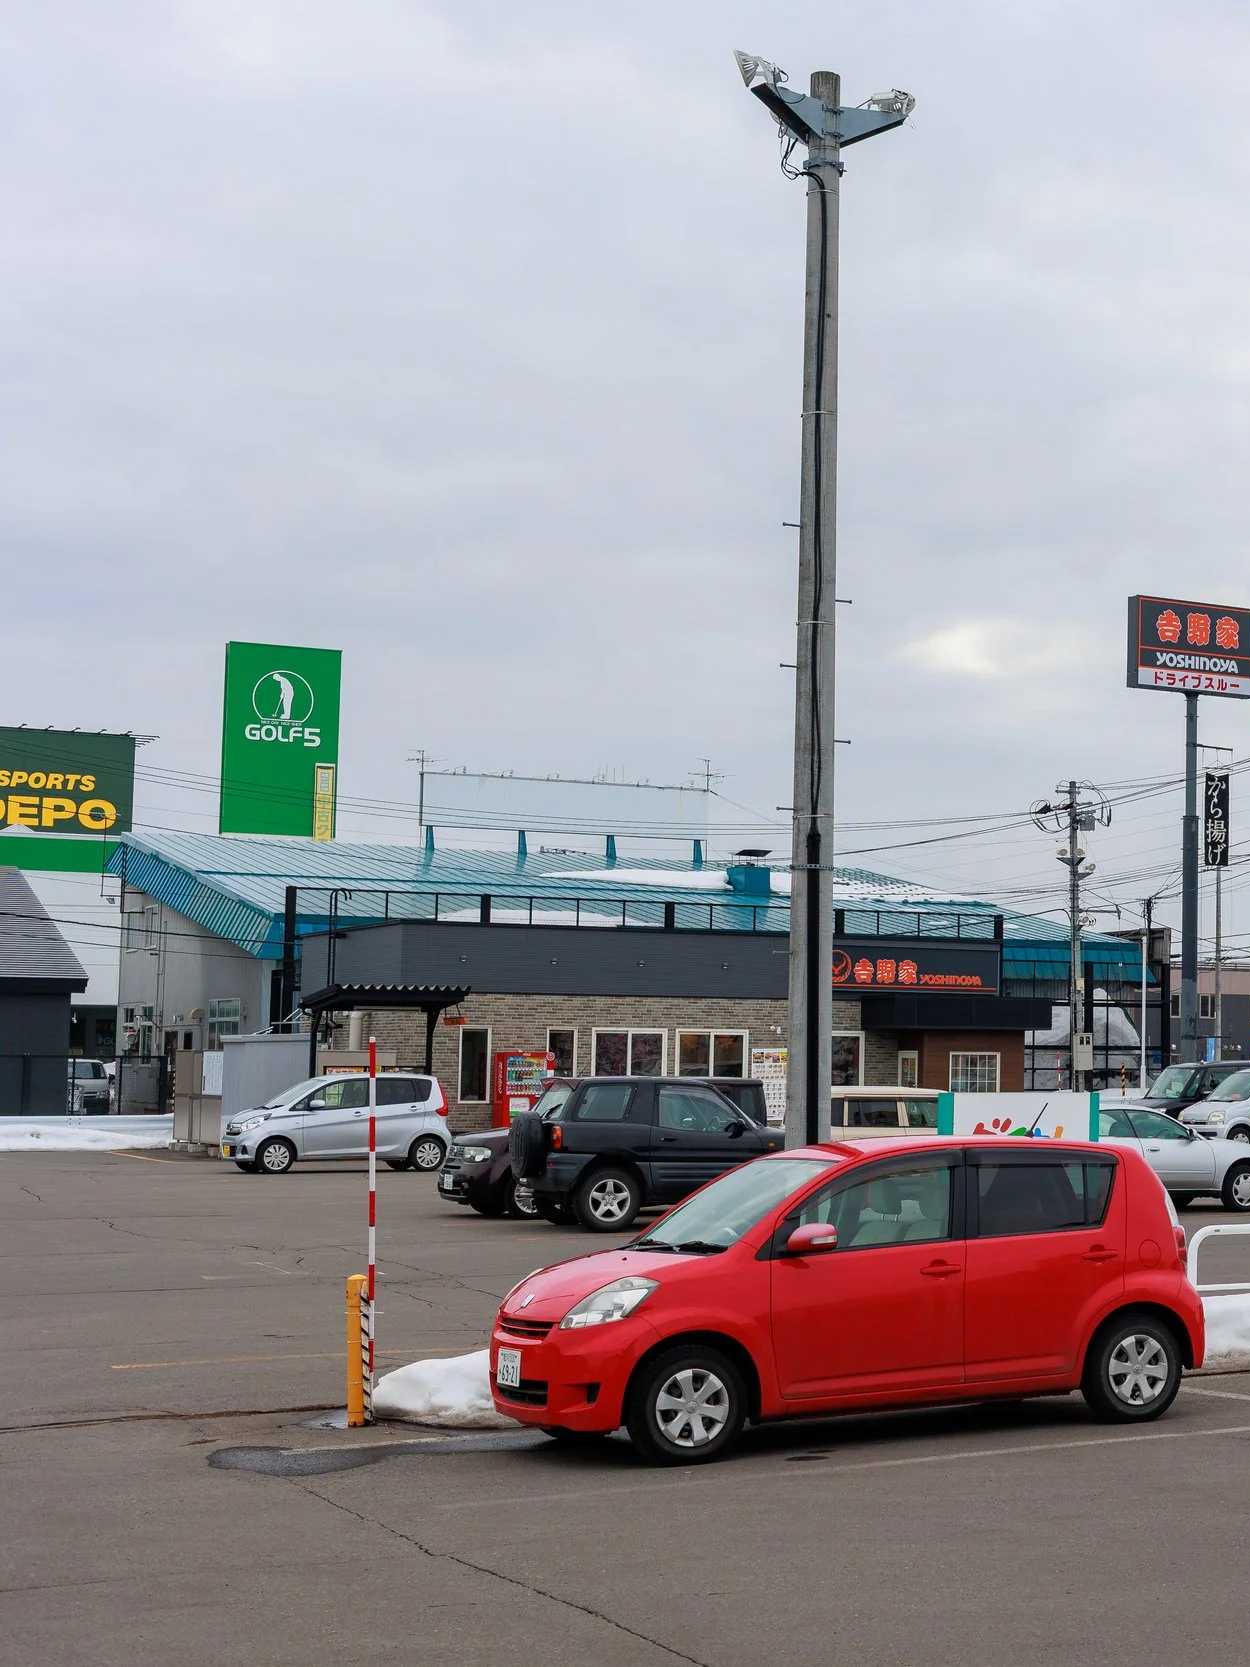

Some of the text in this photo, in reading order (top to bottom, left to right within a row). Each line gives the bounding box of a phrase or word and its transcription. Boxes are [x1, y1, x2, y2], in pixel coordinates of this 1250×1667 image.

[1156, 652, 1239, 674] YOSHINOYA
[1154, 671, 1240, 691] ドライブスルー
[0, 769, 96, 792] SPORTS
[0, 795, 117, 830] EPO
[1206, 776, 1227, 865] から揚げ
[919, 974, 982, 987] YOSHINOYA
